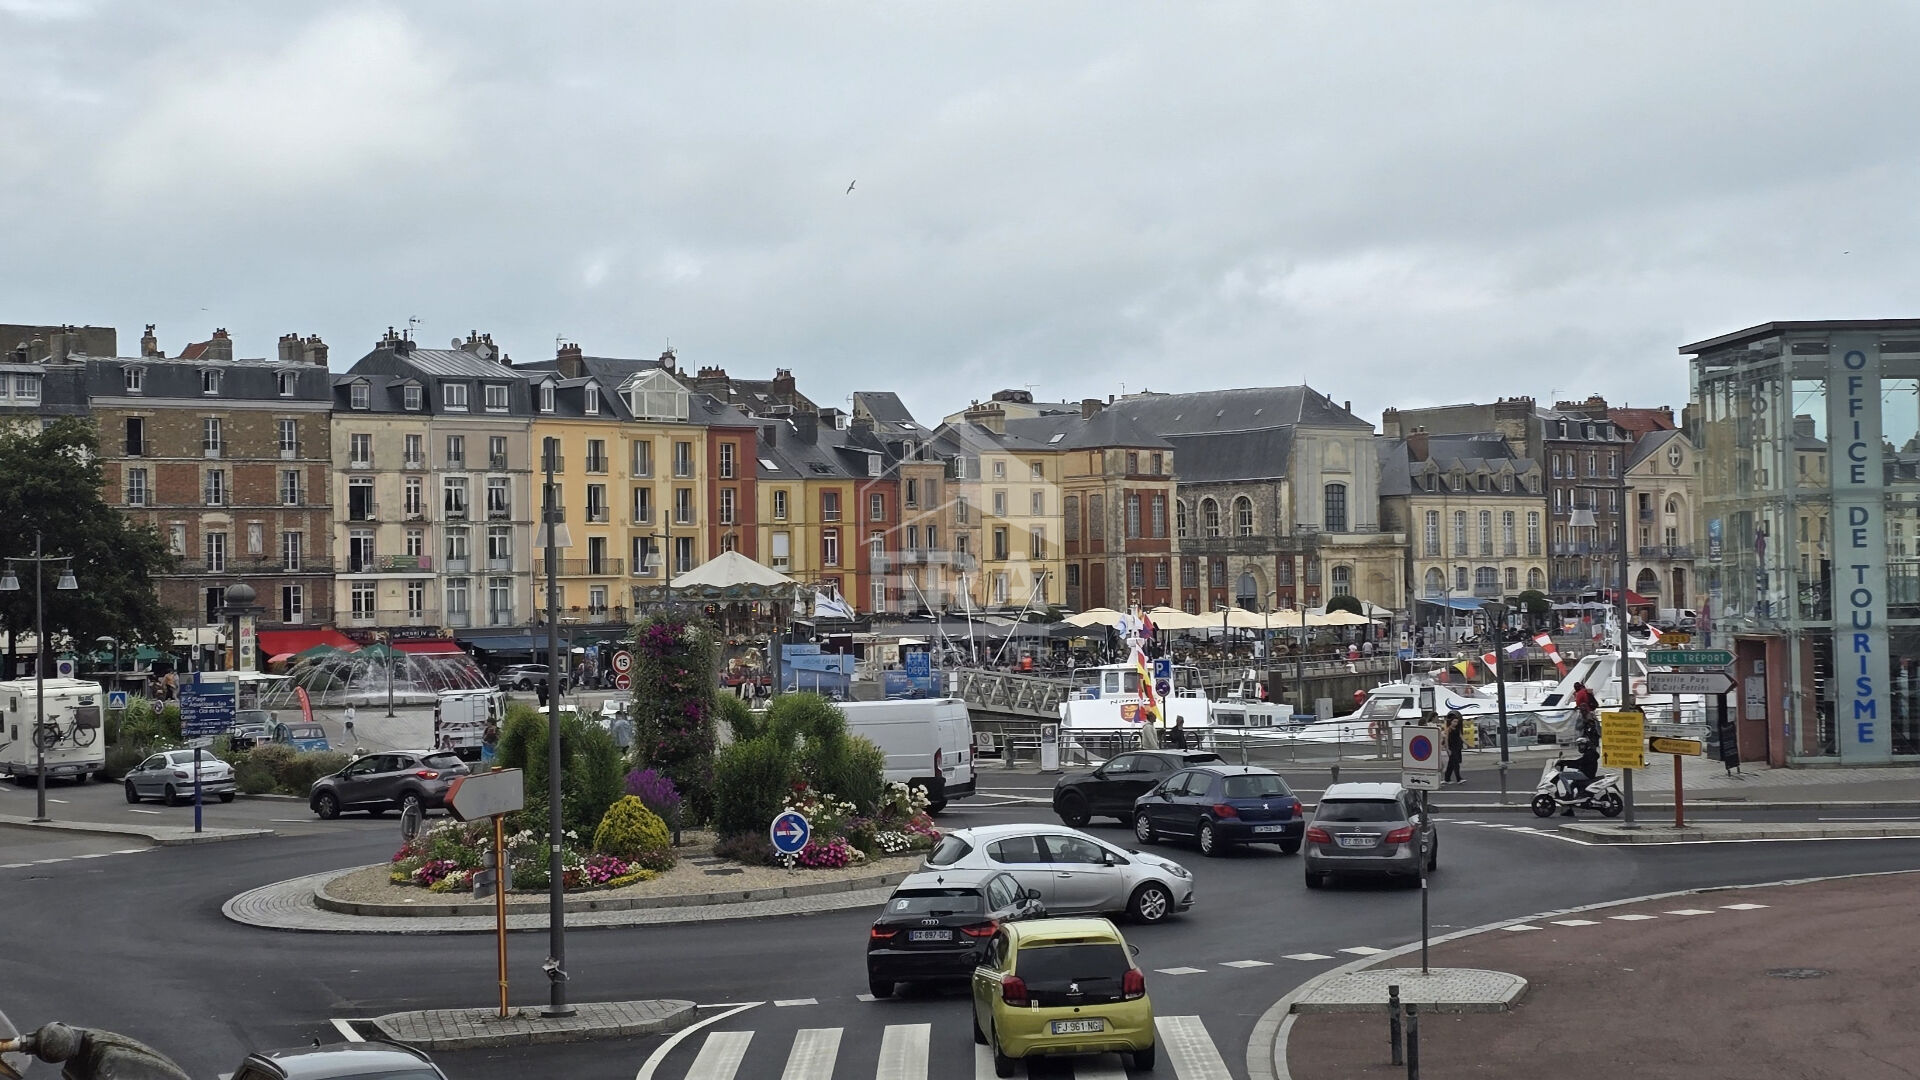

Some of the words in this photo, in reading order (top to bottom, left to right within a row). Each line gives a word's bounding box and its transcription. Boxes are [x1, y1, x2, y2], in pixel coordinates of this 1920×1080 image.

[1844, 350, 1867, 484] OFFICE
[1850, 506, 1869, 548] DE
[1156, 662, 1164, 674] P
[1683, 652, 1725, 662] TRÉPORT
[1850, 564, 1876, 743] TOURISME
